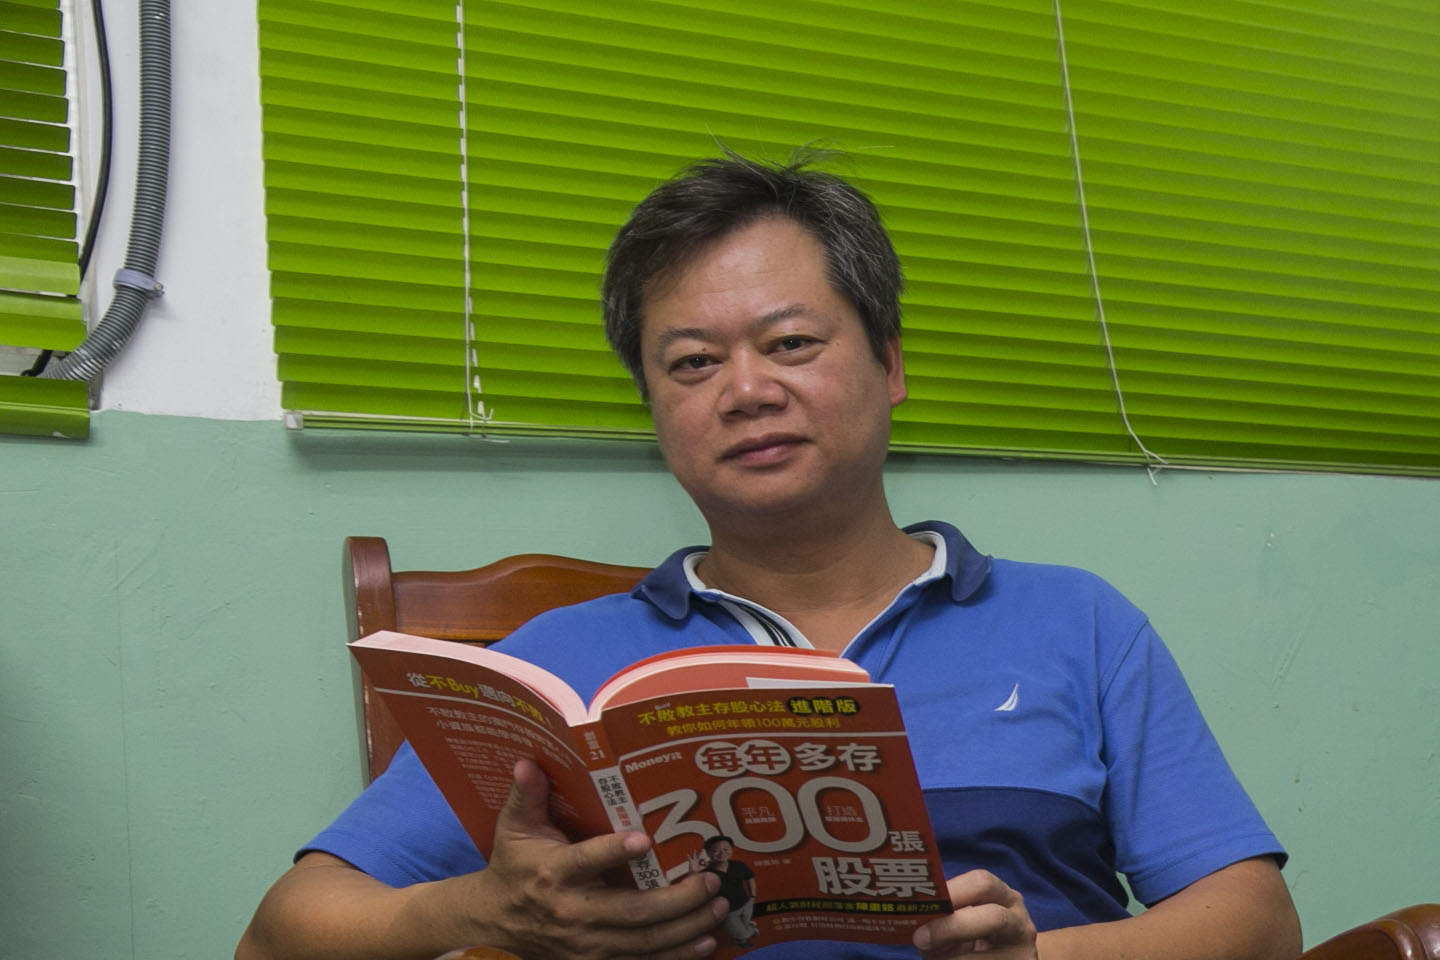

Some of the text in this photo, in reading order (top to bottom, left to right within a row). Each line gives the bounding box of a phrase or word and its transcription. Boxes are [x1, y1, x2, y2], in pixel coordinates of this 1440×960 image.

[790, 698, 858, 715] 進階版
[697, 740, 882, 777] 每年多存
[639, 776, 888, 884] 300
[888, 830, 925, 853] 張
[811, 856, 937, 898] 股票
